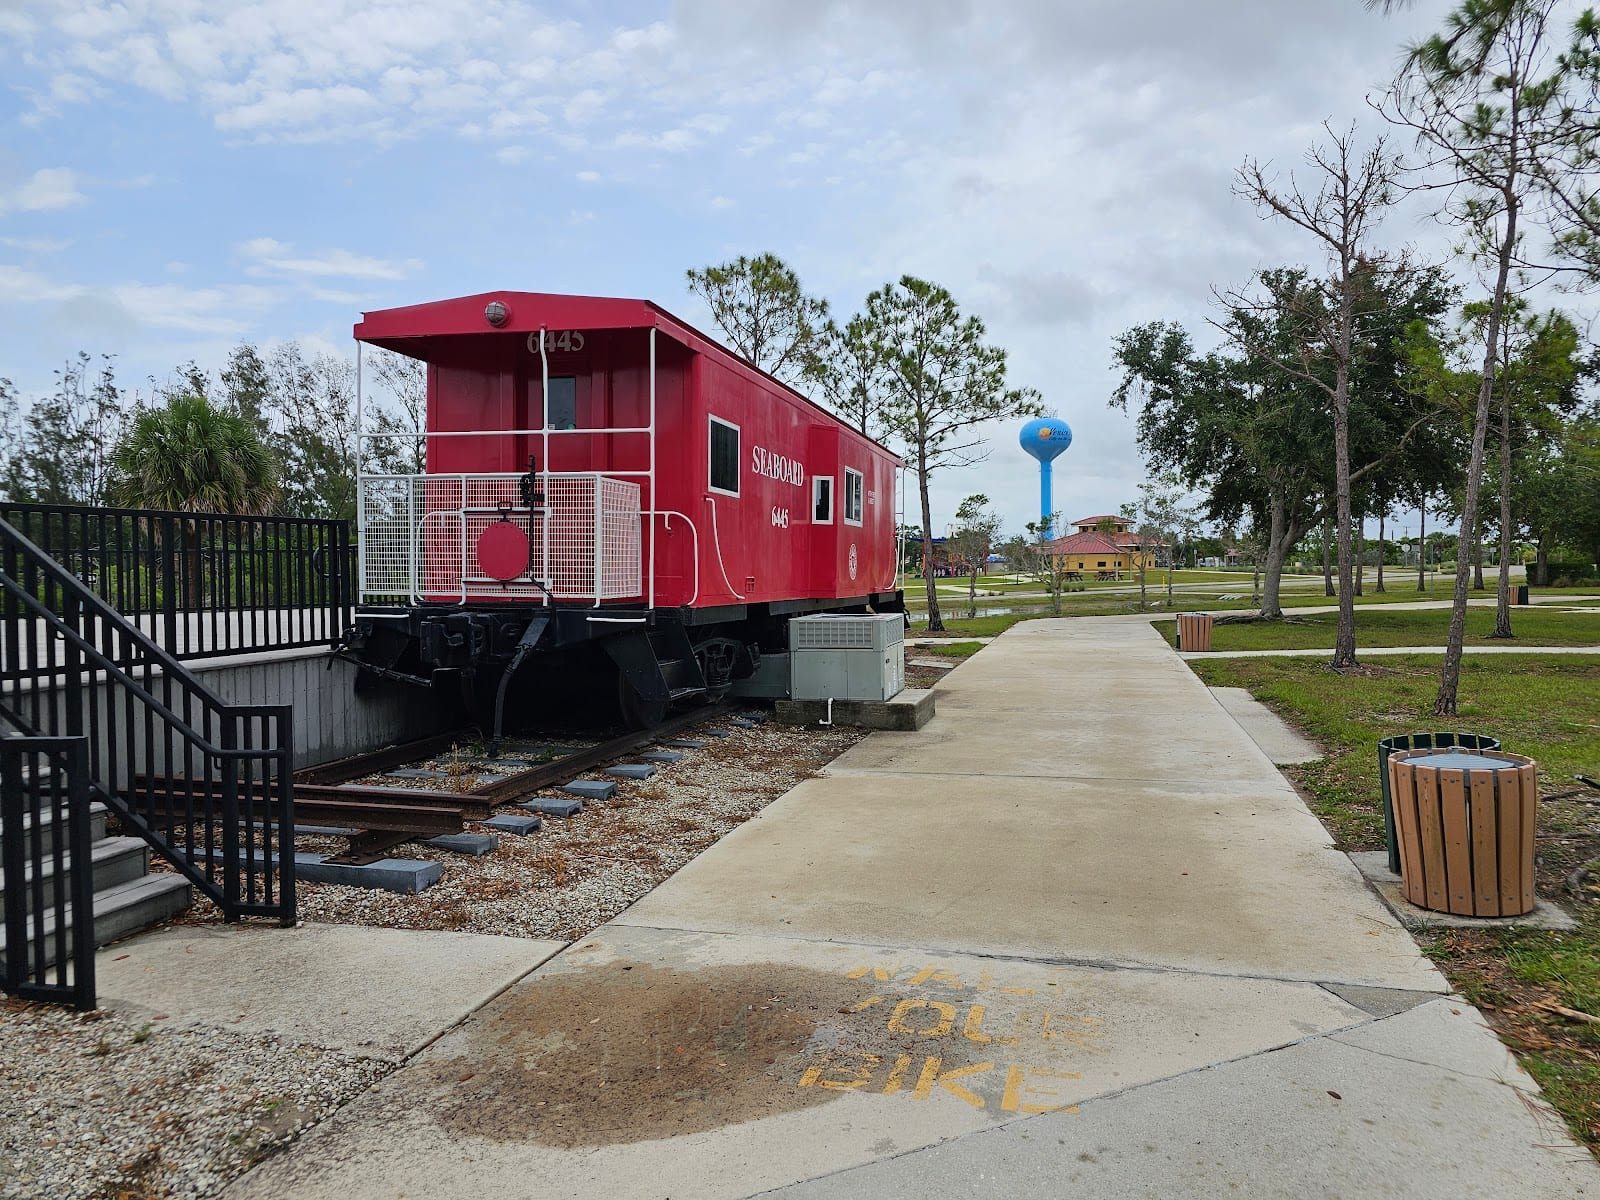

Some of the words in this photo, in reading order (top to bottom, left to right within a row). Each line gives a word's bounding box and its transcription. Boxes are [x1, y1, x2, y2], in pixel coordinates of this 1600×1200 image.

[526, 330, 585, 354] 6445
[752, 445, 804, 487] SEABOARD
[771, 505, 789, 529] 6445
[847, 960, 1065, 996] WAL
[799, 1052, 1082, 1116] BIKE
